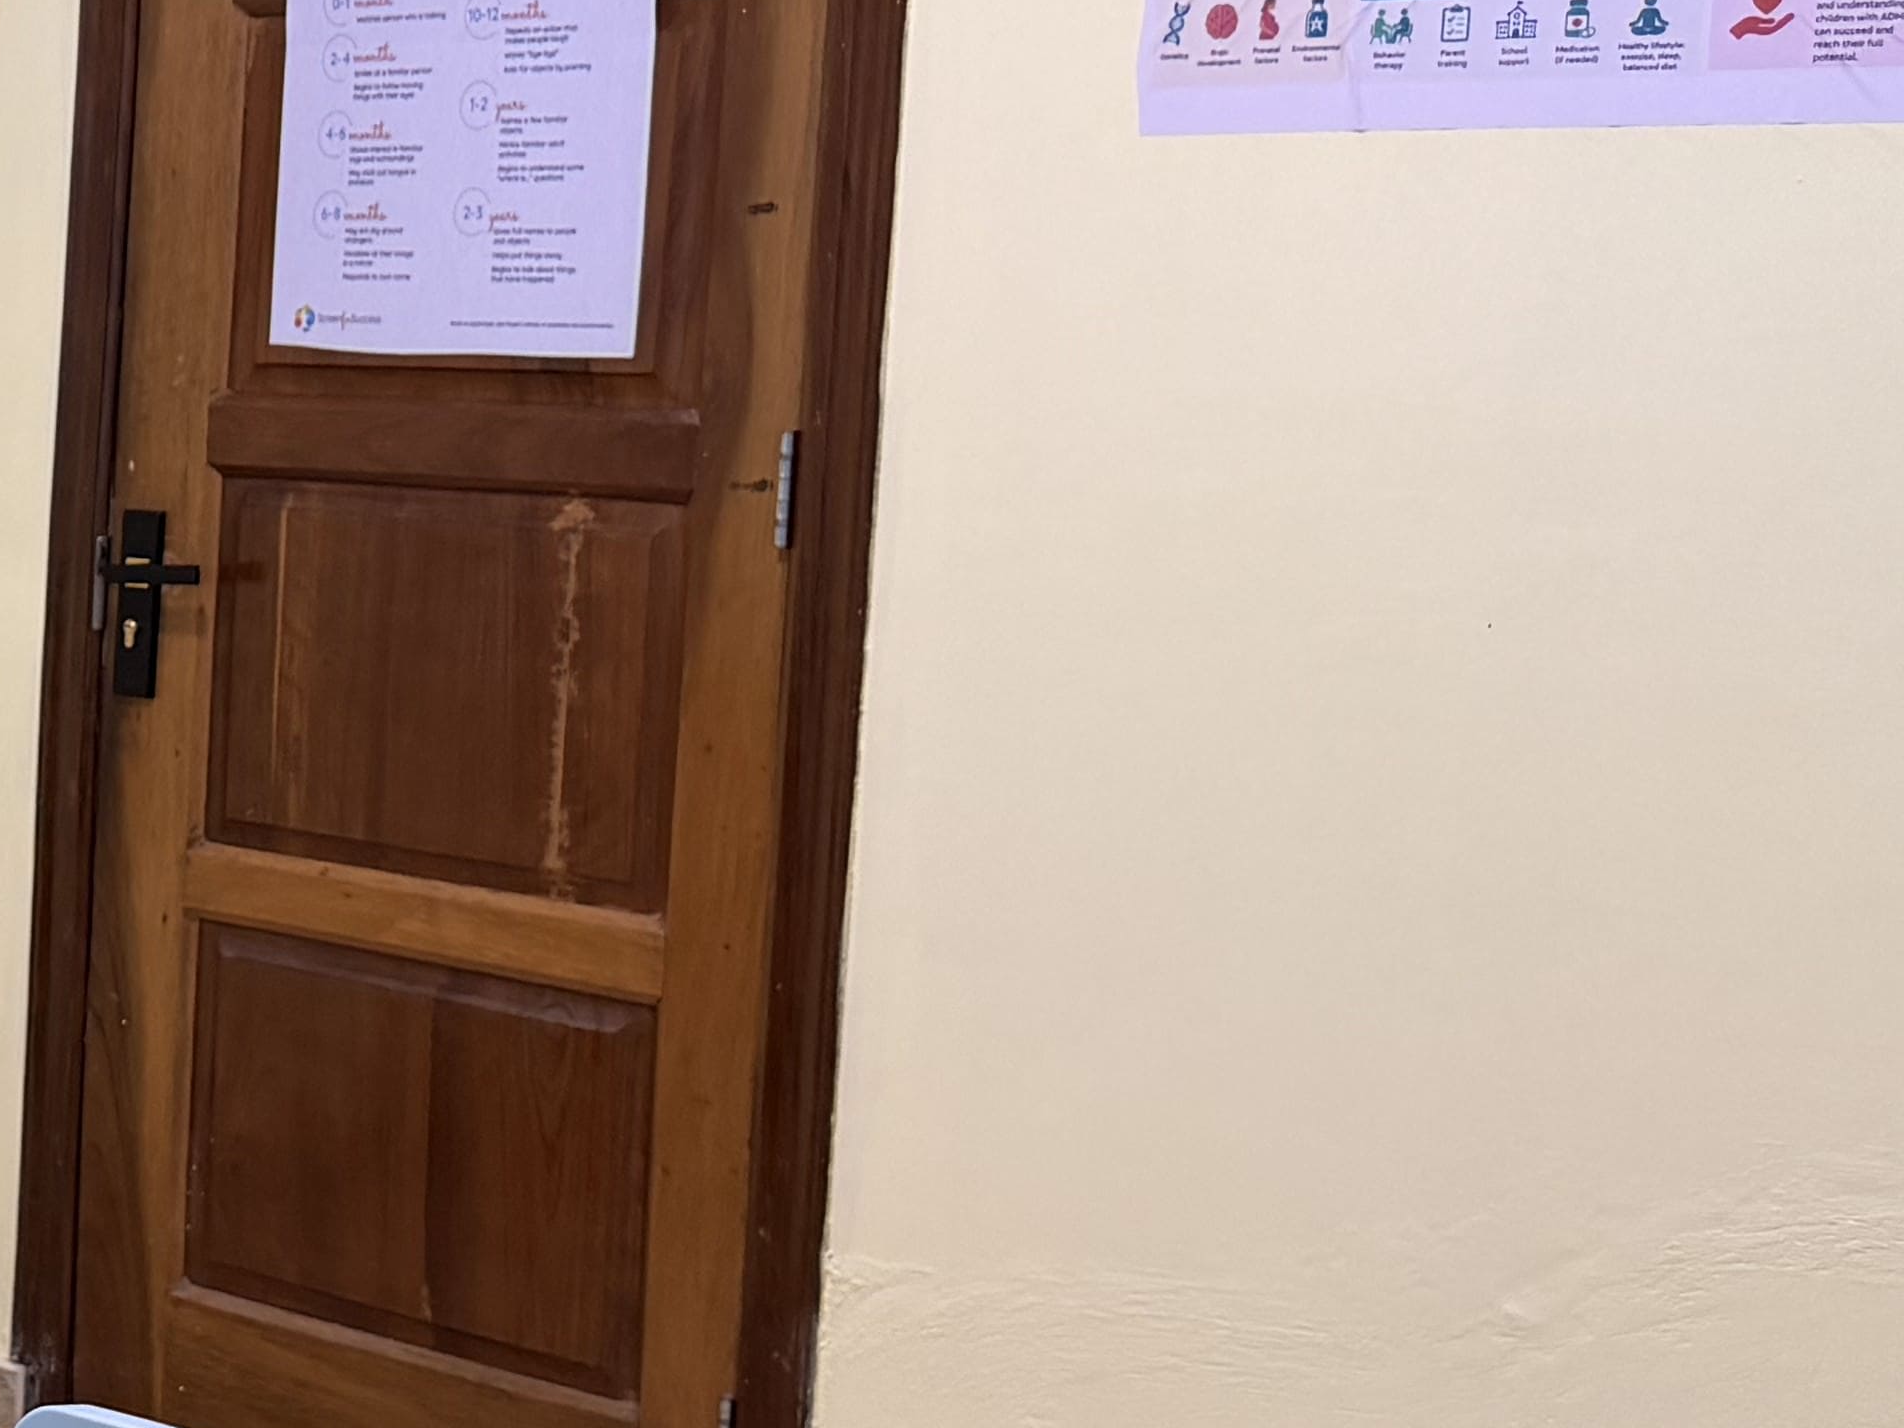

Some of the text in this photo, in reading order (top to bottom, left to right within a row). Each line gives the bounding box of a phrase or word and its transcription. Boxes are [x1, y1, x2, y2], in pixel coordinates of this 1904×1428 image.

[467, 0, 547, 23] 10-12 months
[469, 97, 527, 123] 1-2 years
